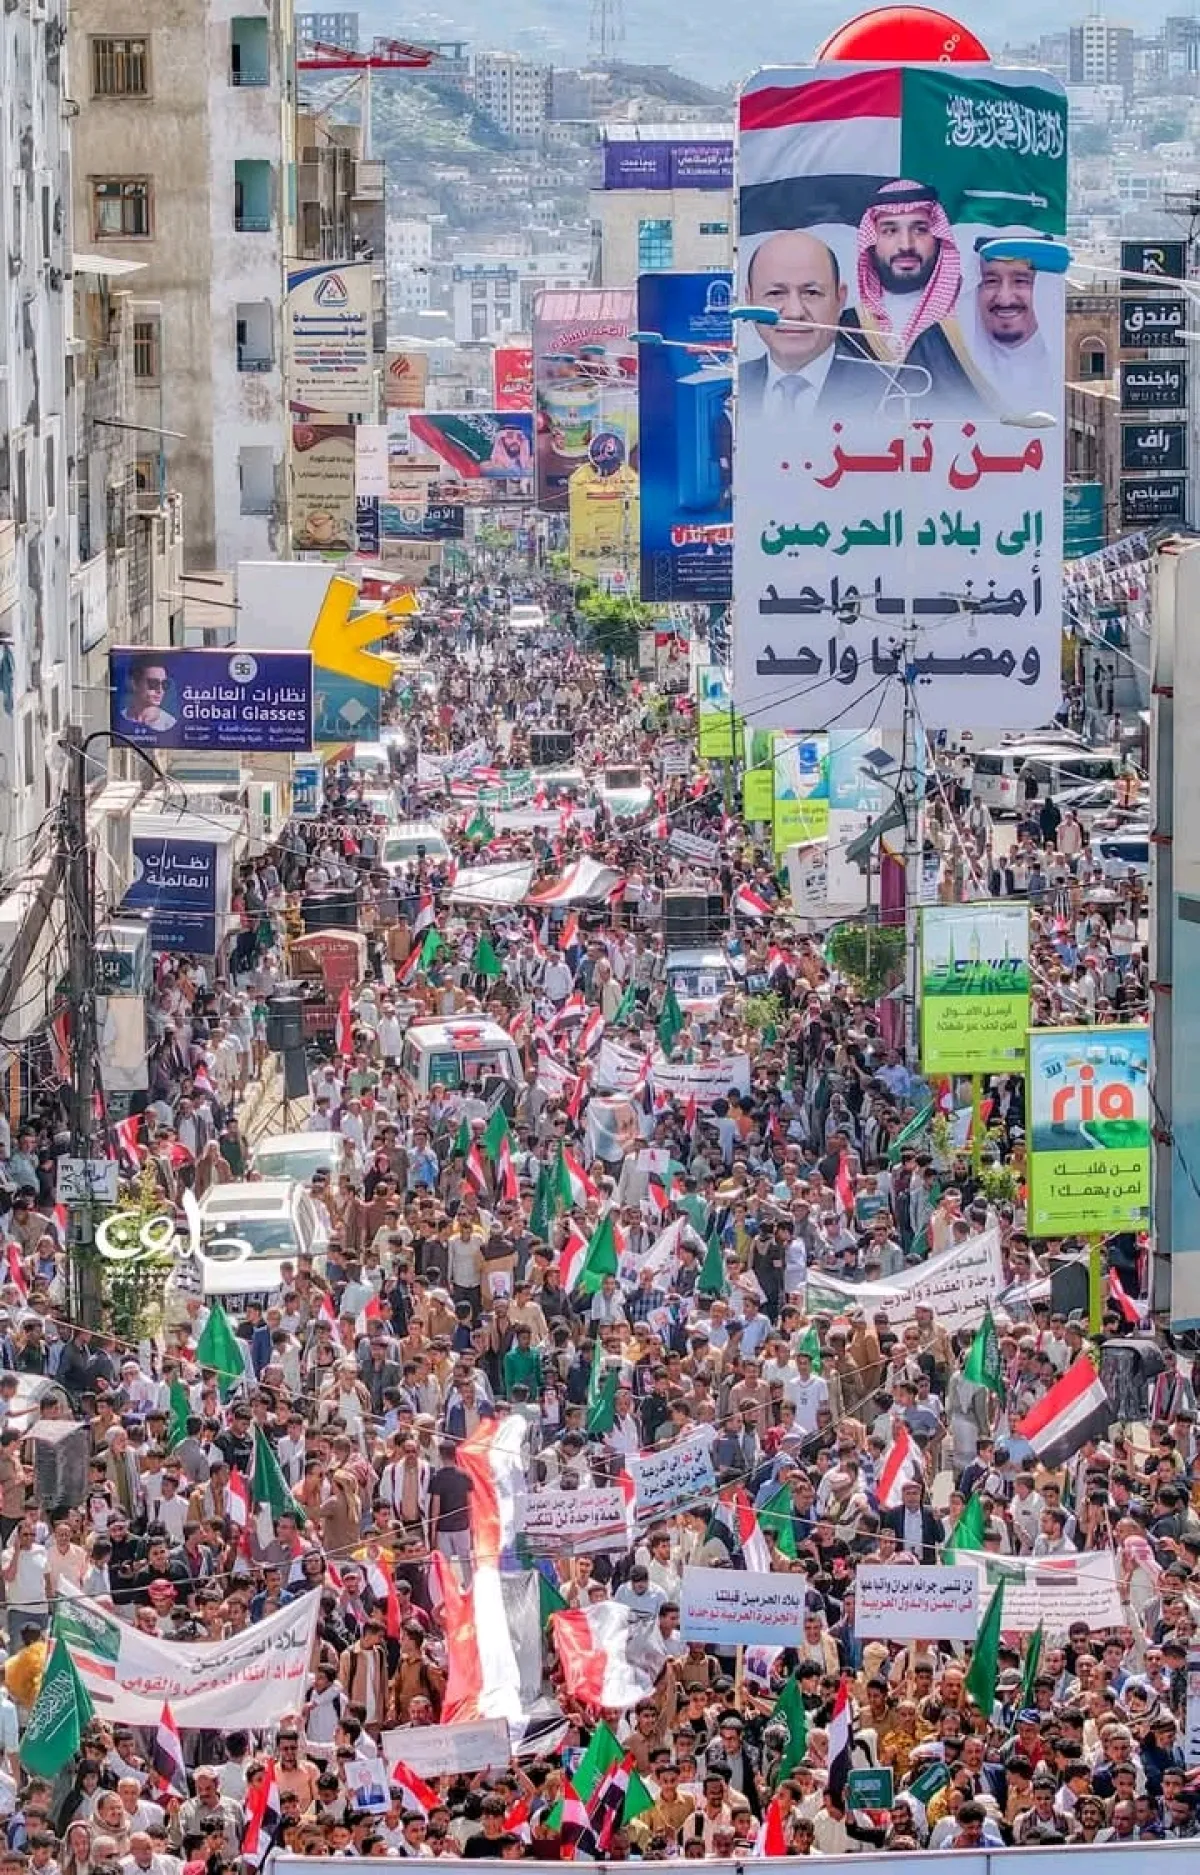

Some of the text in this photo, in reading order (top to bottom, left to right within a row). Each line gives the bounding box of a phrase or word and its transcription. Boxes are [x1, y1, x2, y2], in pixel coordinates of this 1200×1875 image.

[1124, 307, 1181, 331] فندق
[1131, 332, 1178, 346] HOTEL
[1137, 429, 1171, 453] راف
[948, 422, 1044, 490] من
[1126, 485, 1179, 504] السياحي
[760, 509, 903, 557] الحرمين
[917, 510, 981, 555] بلاد
[996, 510, 1043, 558] إلى
[759, 575, 860, 625] واحد
[756, 636, 1042, 686] ومصينا واحد
[182, 685, 306, 706] نظارات العالمية
[183, 704, 306, 721] Global Glasses
[146, 853, 210, 871] نظارات
[146, 871, 209, 889] العالمية
[1052, 1065, 1134, 1122] ria
[60, 1164, 74, 1192] EYE
[1053, 1162, 1141, 1177] من قلبك
[1057, 1184, 1111, 1199] يهمك
[1112, 1181, 1141, 1198] لمن
[962, 1579, 973, 1595] لن
[741, 1591, 781, 1607] الحرمين
[781, 1594, 800, 1609] بلاد
[861, 1597, 973, 1613] في اليمن والدول العربية
[720, 1609, 756, 1623] العربية
